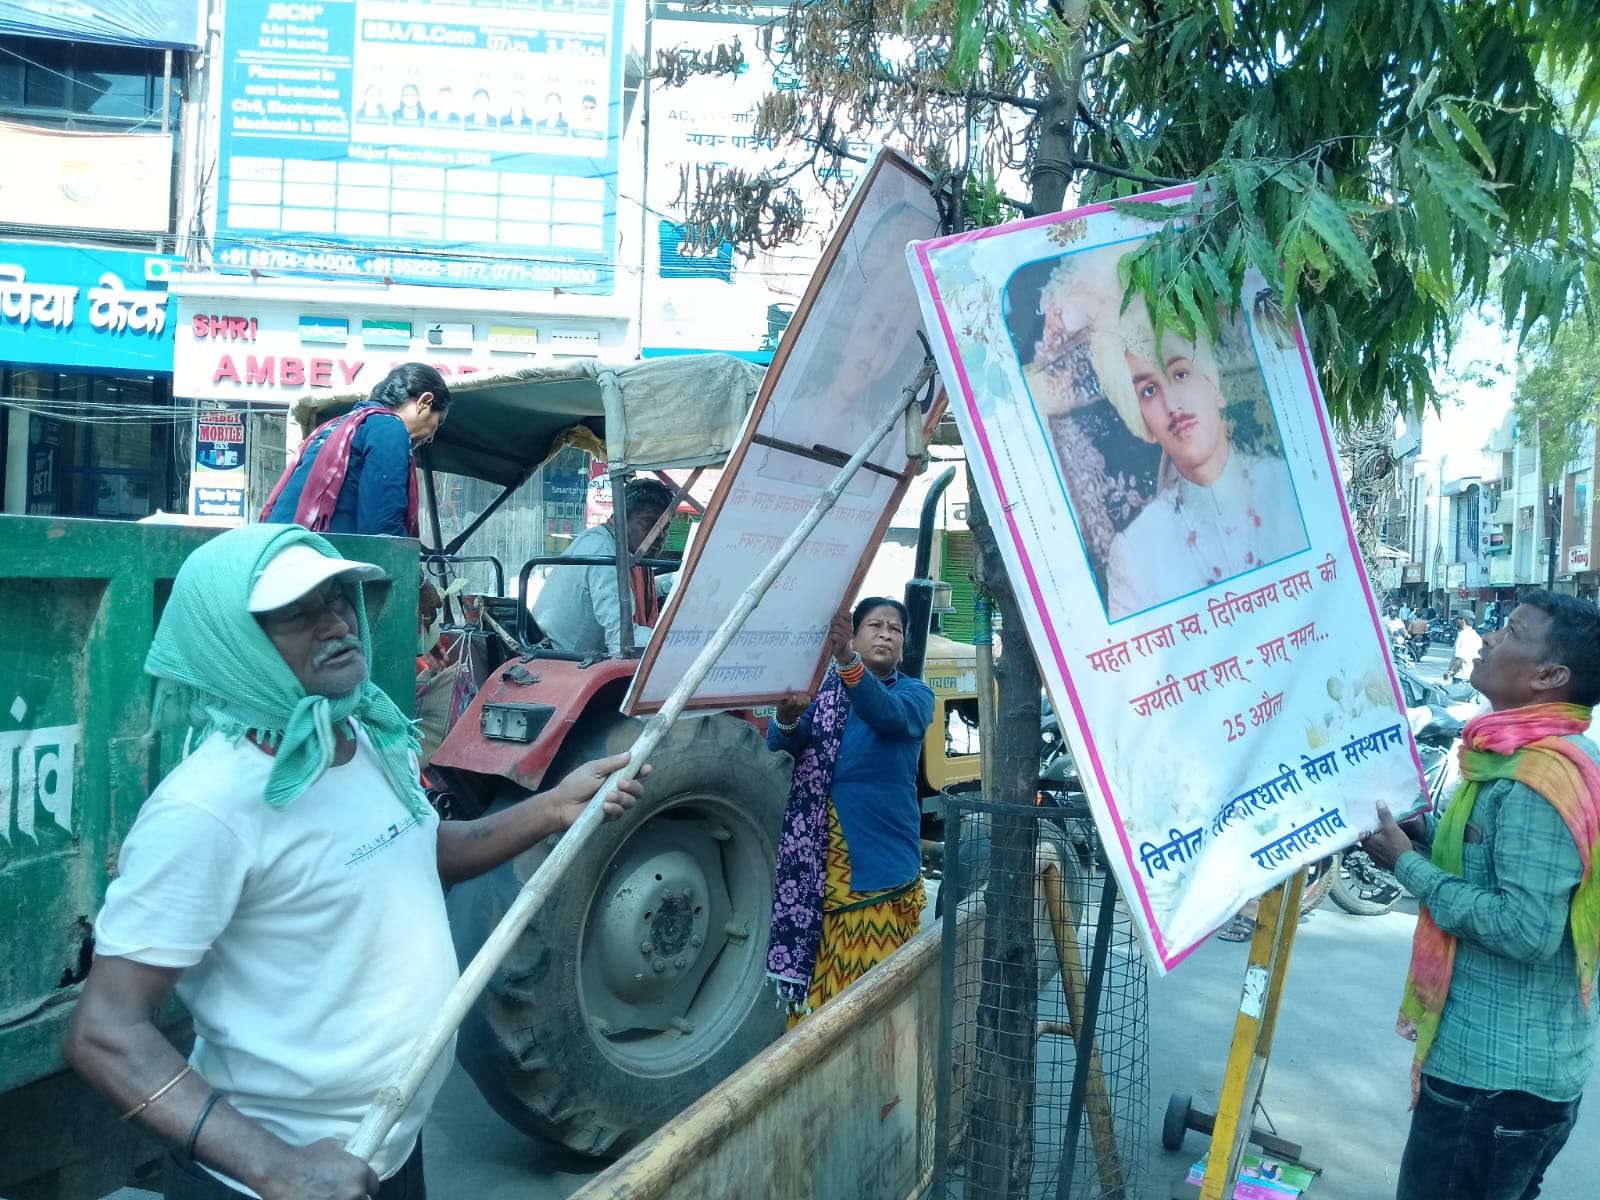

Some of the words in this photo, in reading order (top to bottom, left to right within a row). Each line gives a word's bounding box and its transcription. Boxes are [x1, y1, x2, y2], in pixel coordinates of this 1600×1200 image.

[88, 272, 169, 334] केक
[191, 313, 258, 341] SHRI
[301, 322, 347, 337] vivo
[212, 353, 364, 388] AMBEY
[199, 425, 243, 442] MOBILE
[1086, 639, 1132, 674] महंत
[1132, 624, 1176, 659] राजा
[1176, 613, 1208, 640] स्व.
[1207, 583, 1278, 629] दिग्विजय
[1279, 570, 1313, 602] दास
[1315, 552, 1338, 583] की
[1128, 674, 1184, 720] जयंती
[1183, 668, 1208, 696] पर
[1210, 655, 1250, 689] शत्
[1256, 635, 1291, 667] शत्
[1222, 712, 1247, 743] 25
[1249, 690, 1285, 729] अप्रैल
[1301, 746, 1339, 785] सेवा
[1340, 721, 1404, 767] संस्थान
[1250, 806, 1347, 872] राजनांदगांव
